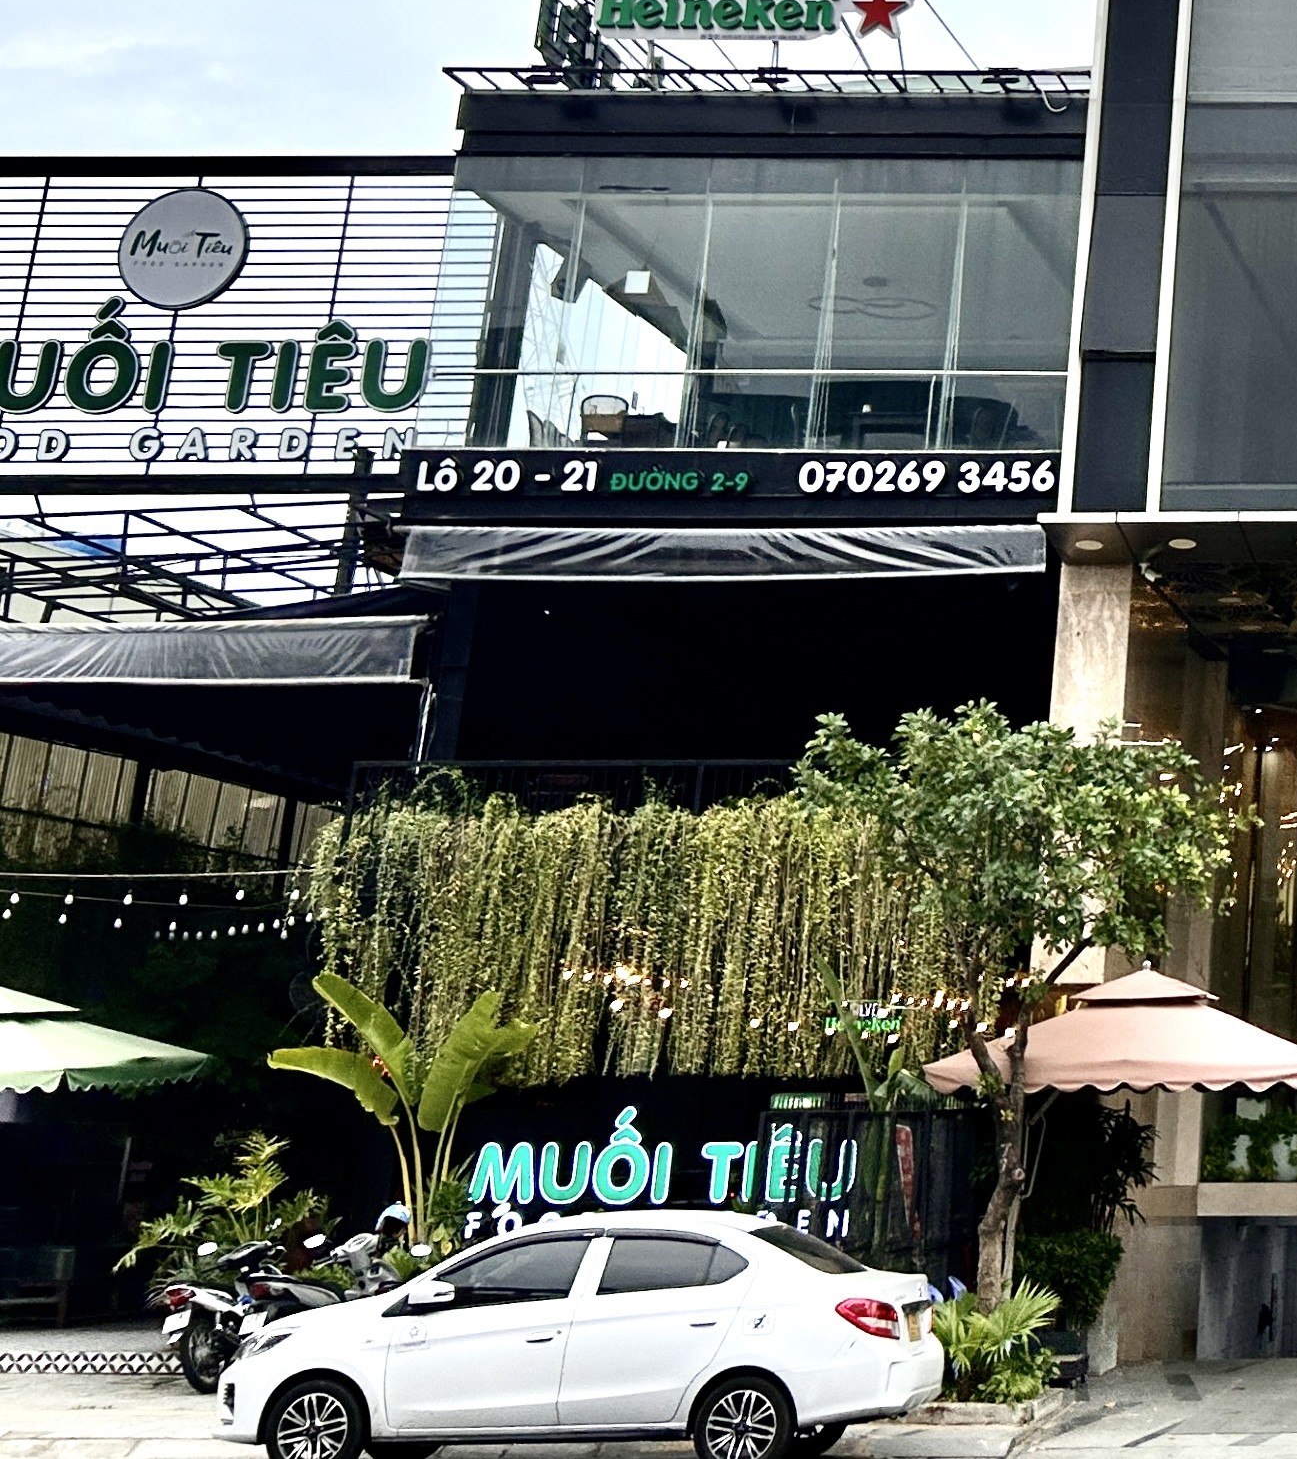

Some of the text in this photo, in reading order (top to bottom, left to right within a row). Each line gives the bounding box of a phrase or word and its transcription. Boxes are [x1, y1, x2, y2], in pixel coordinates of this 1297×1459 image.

[216, 319, 432, 414] TIÊU
[129, 427, 417, 461] GARDEN
[416, 457, 458, 492] Lô
[471, 459, 521, 492] 20
[560, 459, 598, 492] 21
[610, 465, 699, 492] ĐƯỜNG
[711, 472, 748, 491] 2-9
[798, 460, 946, 493] 070269
[957, 459, 1055, 493] 3456
[468, 1105, 673, 1205] MUỐI
